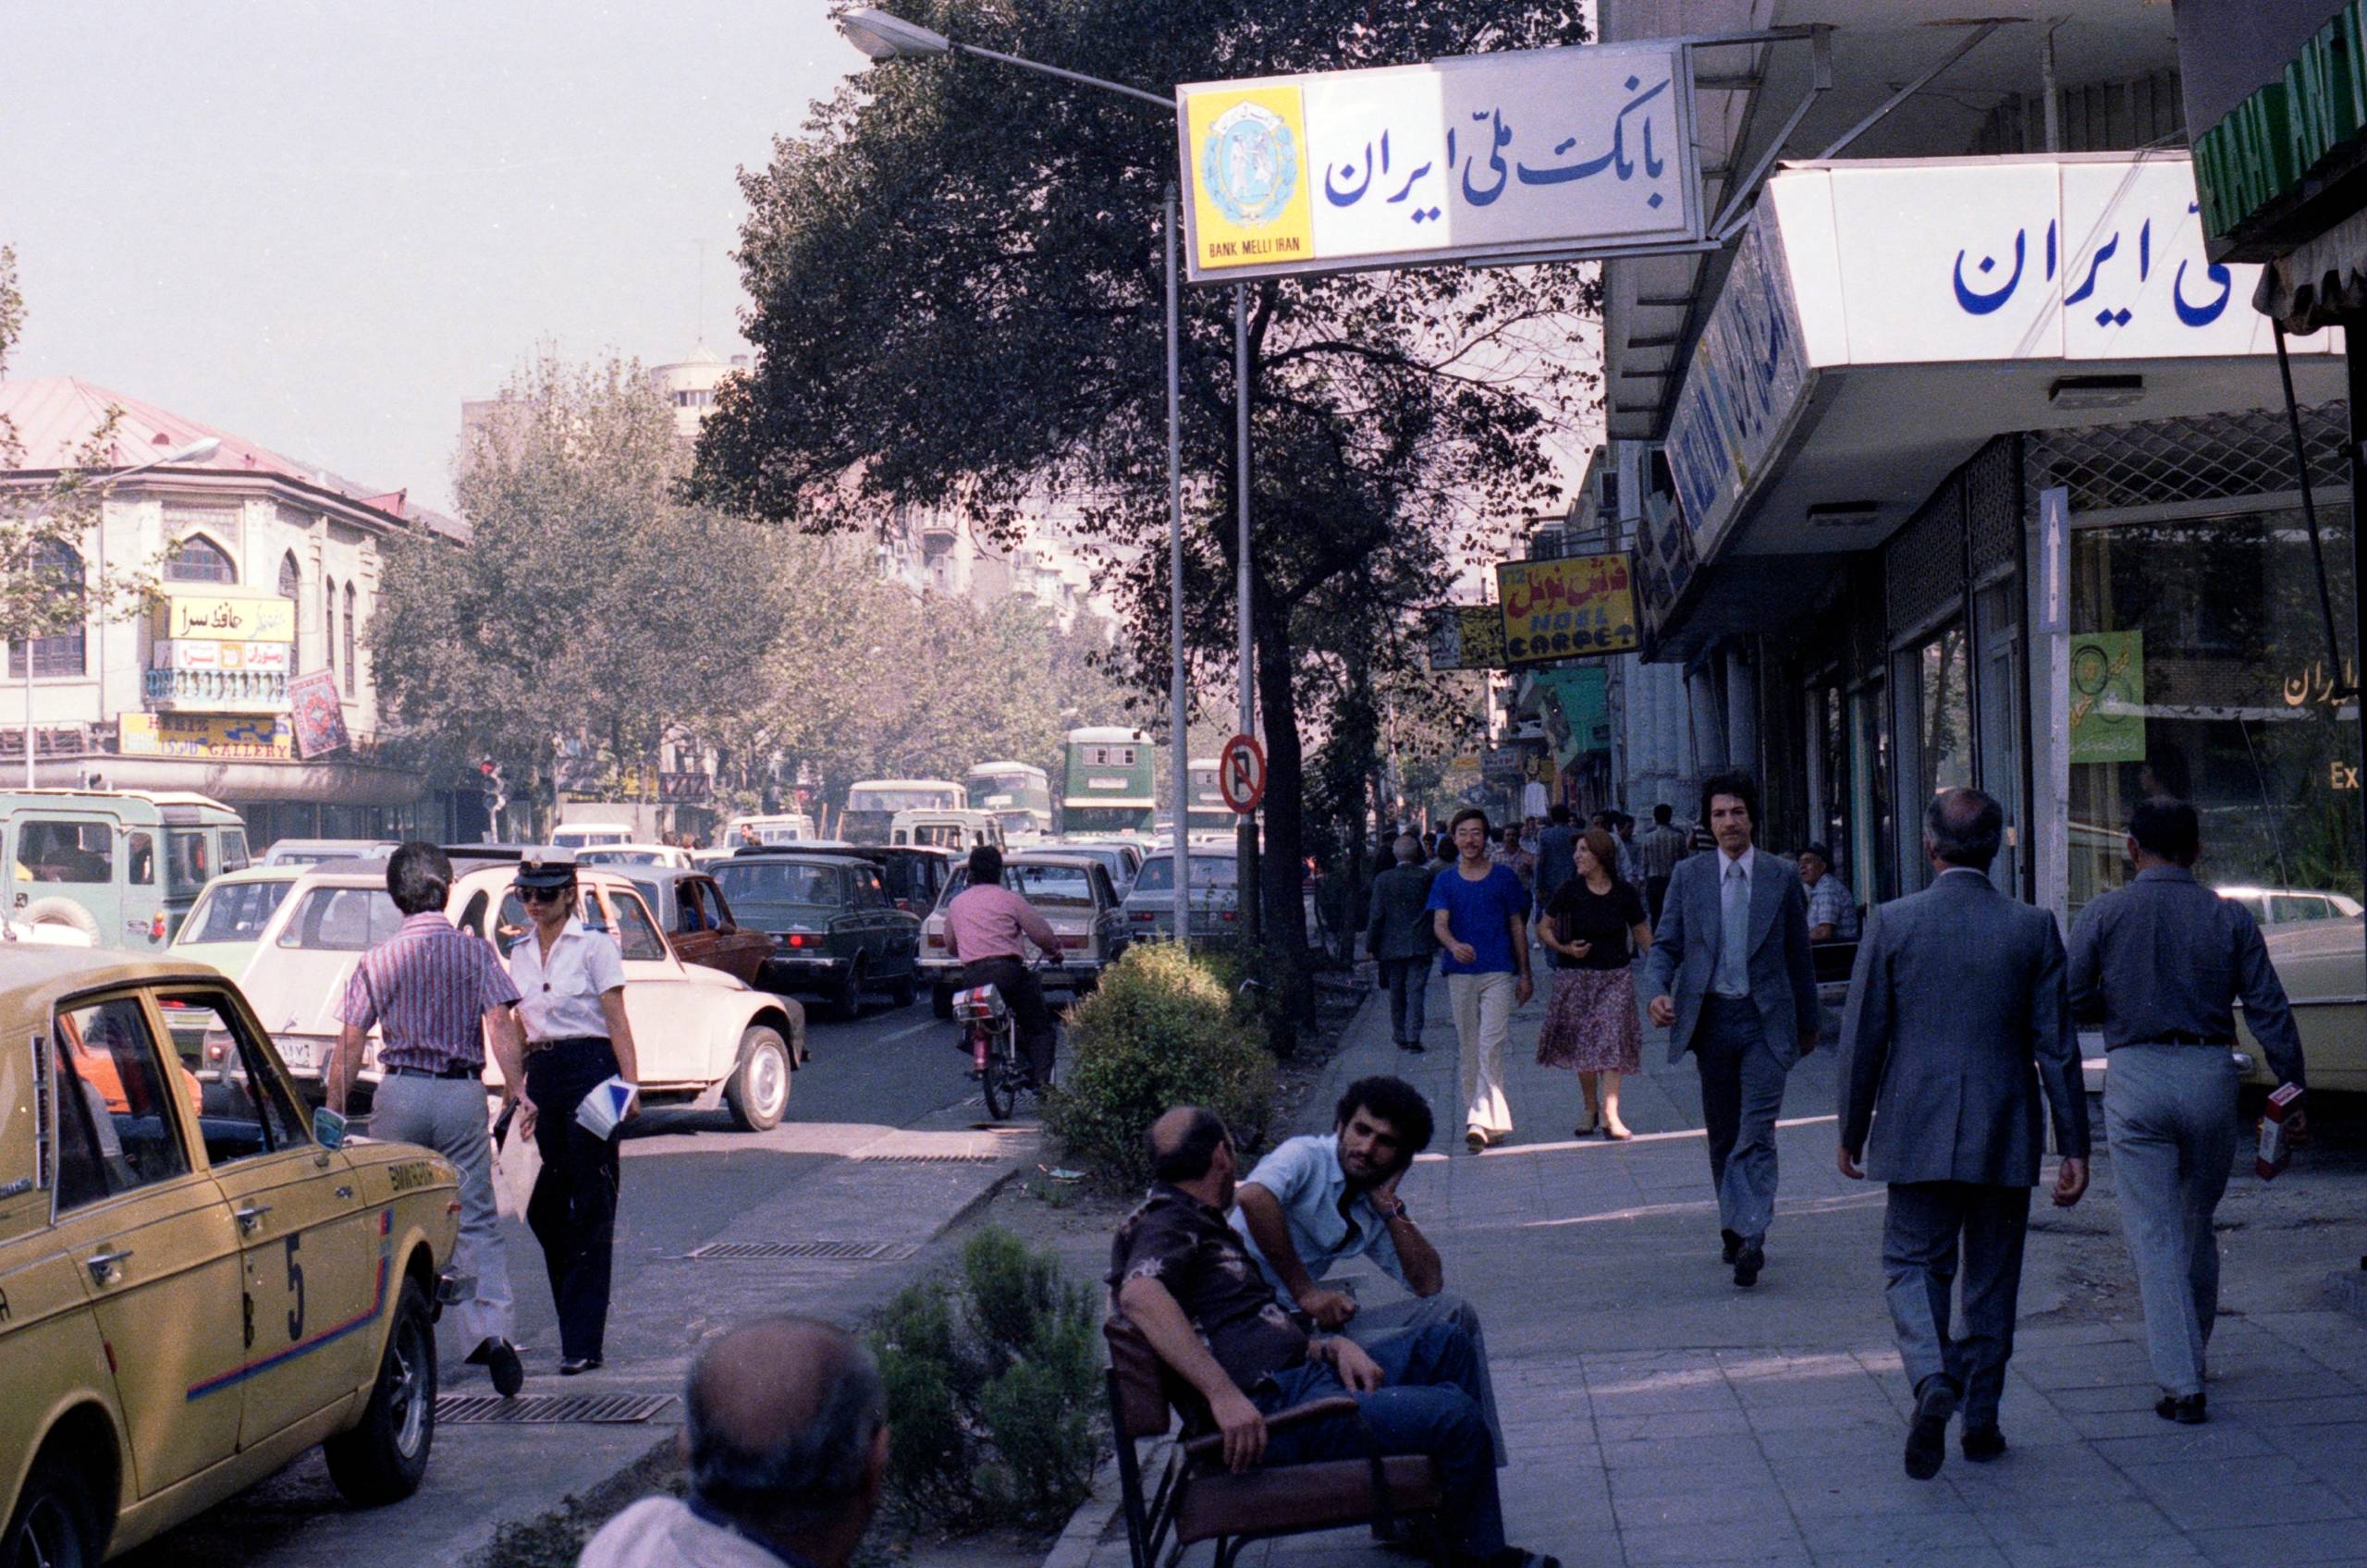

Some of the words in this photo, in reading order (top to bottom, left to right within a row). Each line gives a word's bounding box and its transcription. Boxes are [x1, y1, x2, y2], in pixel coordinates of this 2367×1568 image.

[1517, 75, 1671, 210] بانک
[1323, 127, 1457, 225] ایران
[1208, 241, 1237, 258] BANK
[1242, 239, 1271, 255] MELLI
[1275, 236, 1301, 253] IRAN
[1953, 217, 2151, 327] ایران
[178, 604, 209, 636] سرا
[211, 601, 243, 630] حافظ
[1530, 606, 1609, 633] NOEL
[1507, 623, 1635, 658] CARPET
[207, 742, 288, 758] GALLERY
[2329, 761, 2361, 790] Ex
[285, 1231, 305, 1341] 5
